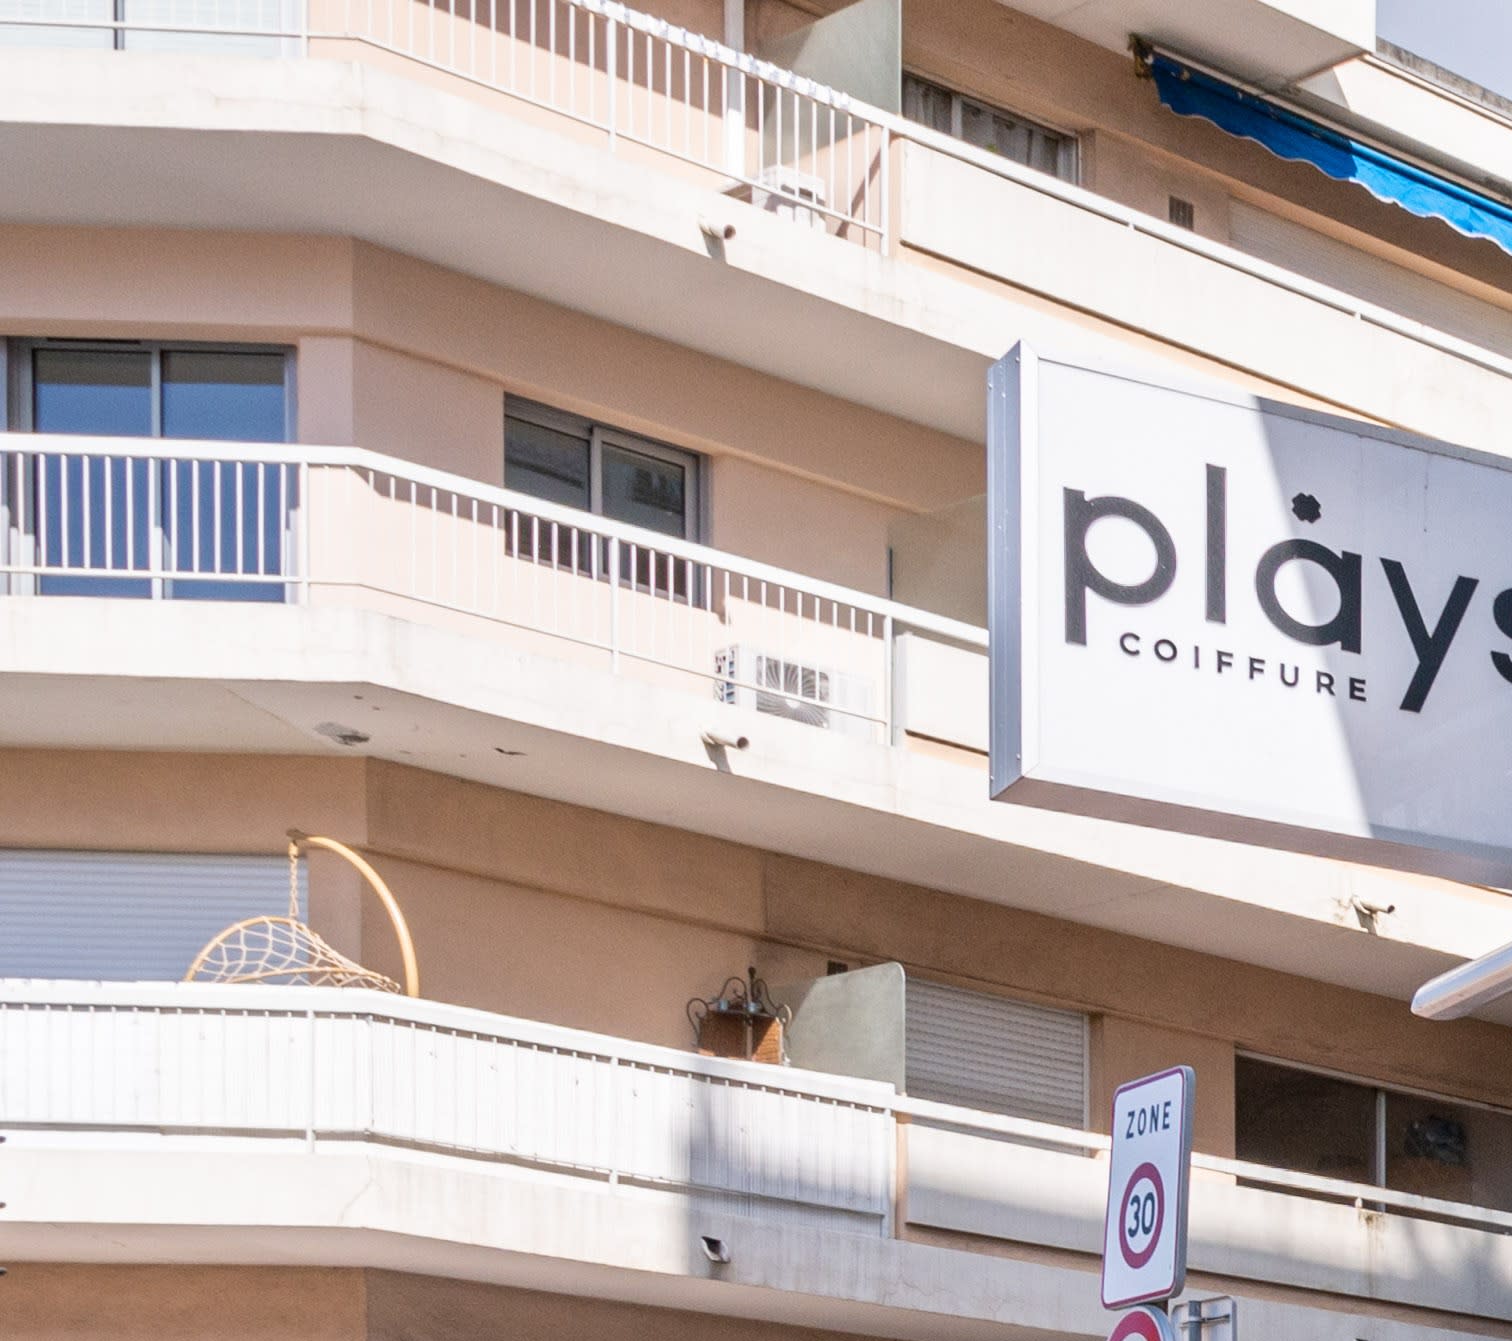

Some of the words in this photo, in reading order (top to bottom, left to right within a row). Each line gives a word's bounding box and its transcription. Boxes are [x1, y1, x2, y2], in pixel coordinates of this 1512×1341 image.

[1119, 631, 1368, 702] COIFFURE
[1125, 1100, 1172, 1140] ZONE
[1127, 1191, 1156, 1239] 30
